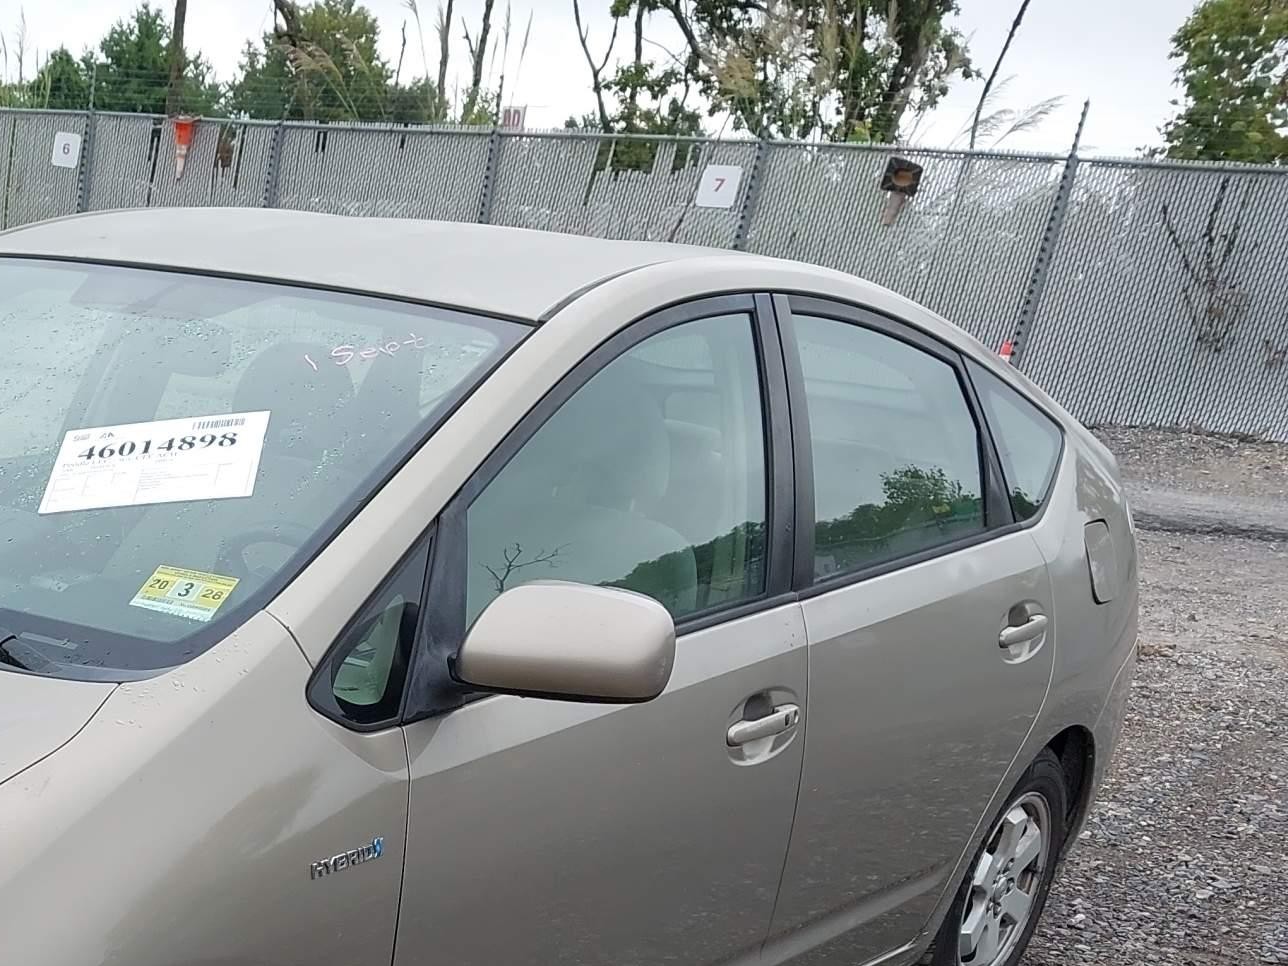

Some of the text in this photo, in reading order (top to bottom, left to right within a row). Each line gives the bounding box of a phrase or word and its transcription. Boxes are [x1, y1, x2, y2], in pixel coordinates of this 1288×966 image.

[62, 143, 71, 156] 6
[714, 177, 727, 193] 7
[76, 431, 239, 461] 46014898
[149, 579, 169, 590] 20
[177, 582, 195, 598] 3
[310, 844, 374, 880] HYBRID
